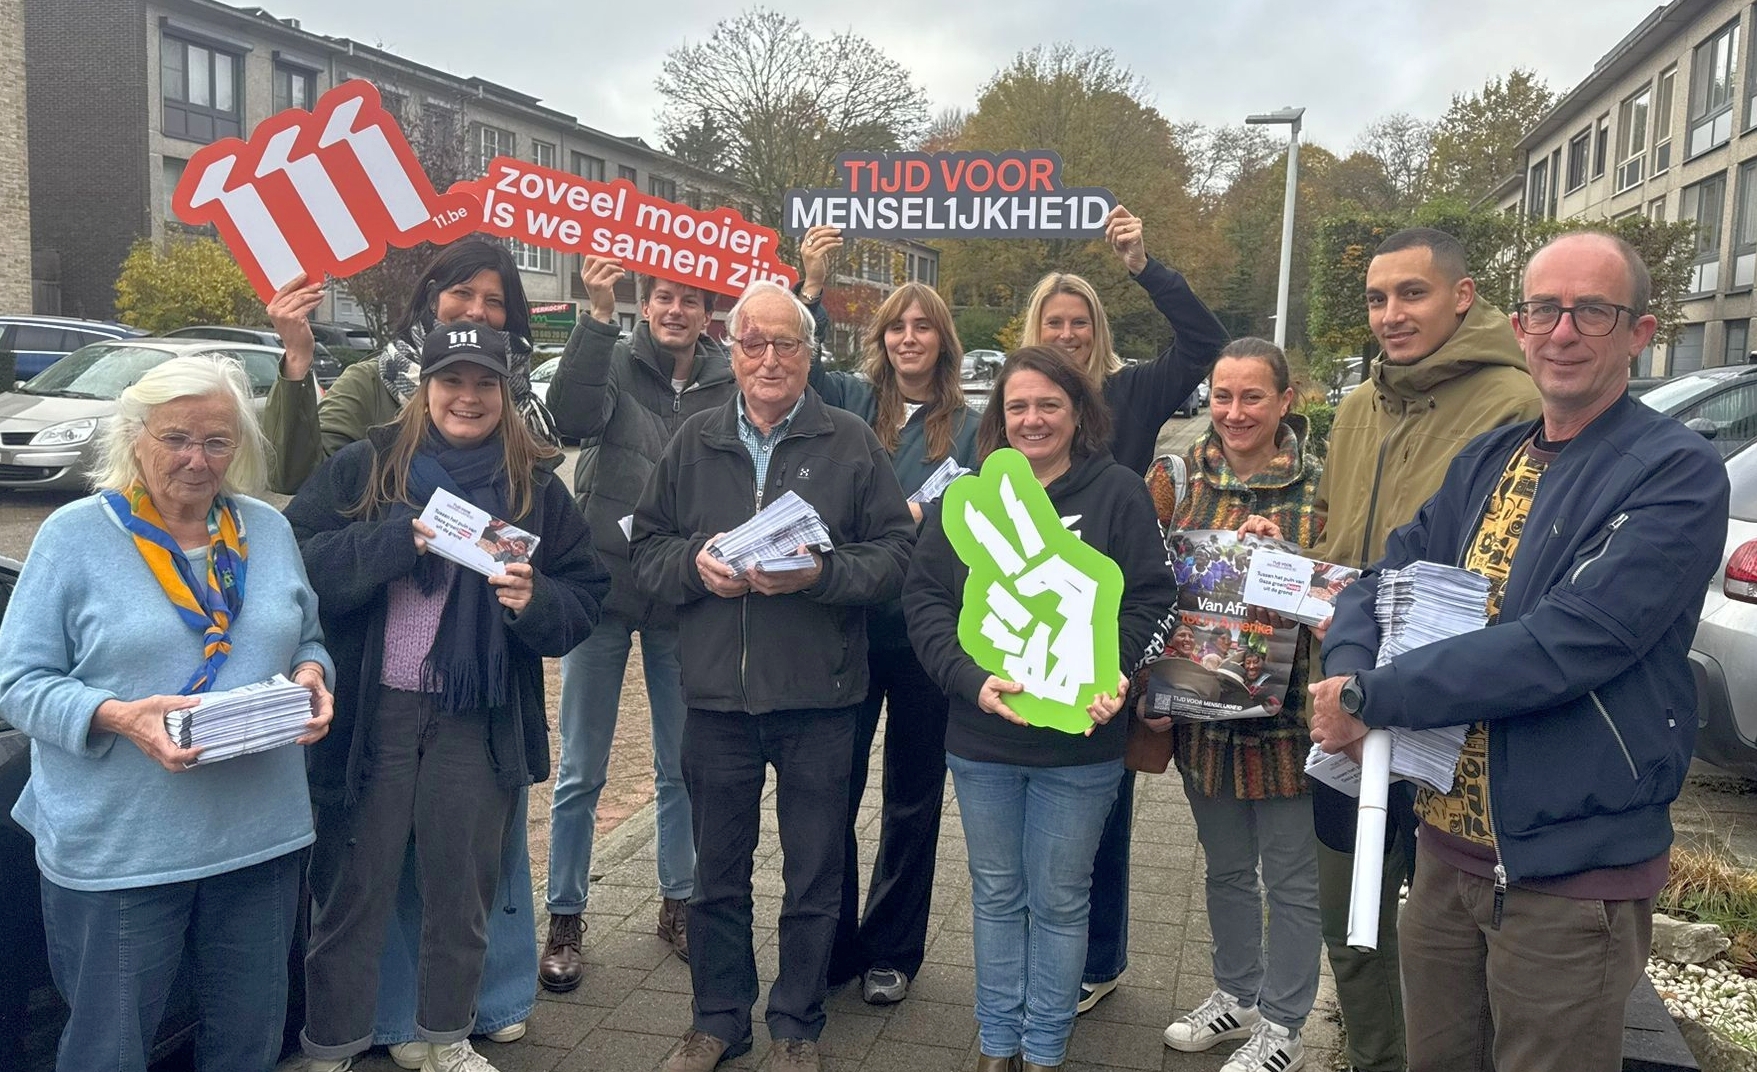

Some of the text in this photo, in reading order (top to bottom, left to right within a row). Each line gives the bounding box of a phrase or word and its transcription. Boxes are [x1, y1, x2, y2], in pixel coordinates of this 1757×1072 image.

[844, 158, 1054, 192] T1JD VOOR
[432, 207, 468, 229] 11.be
[496, 166, 768, 258] zoveel mooier
[791, 197, 1110, 230] MENSEL1JKHE1D
[483, 188, 515, 228] ls
[526, 208, 582, 245] we
[591, 226, 720, 281] samen
[531, 304, 569, 314] VERKOCHT
[1197, 596, 1223, 613] Van
[1219, 615, 1274, 636] Amerika
[1186, 698, 1203, 706] VOOR
